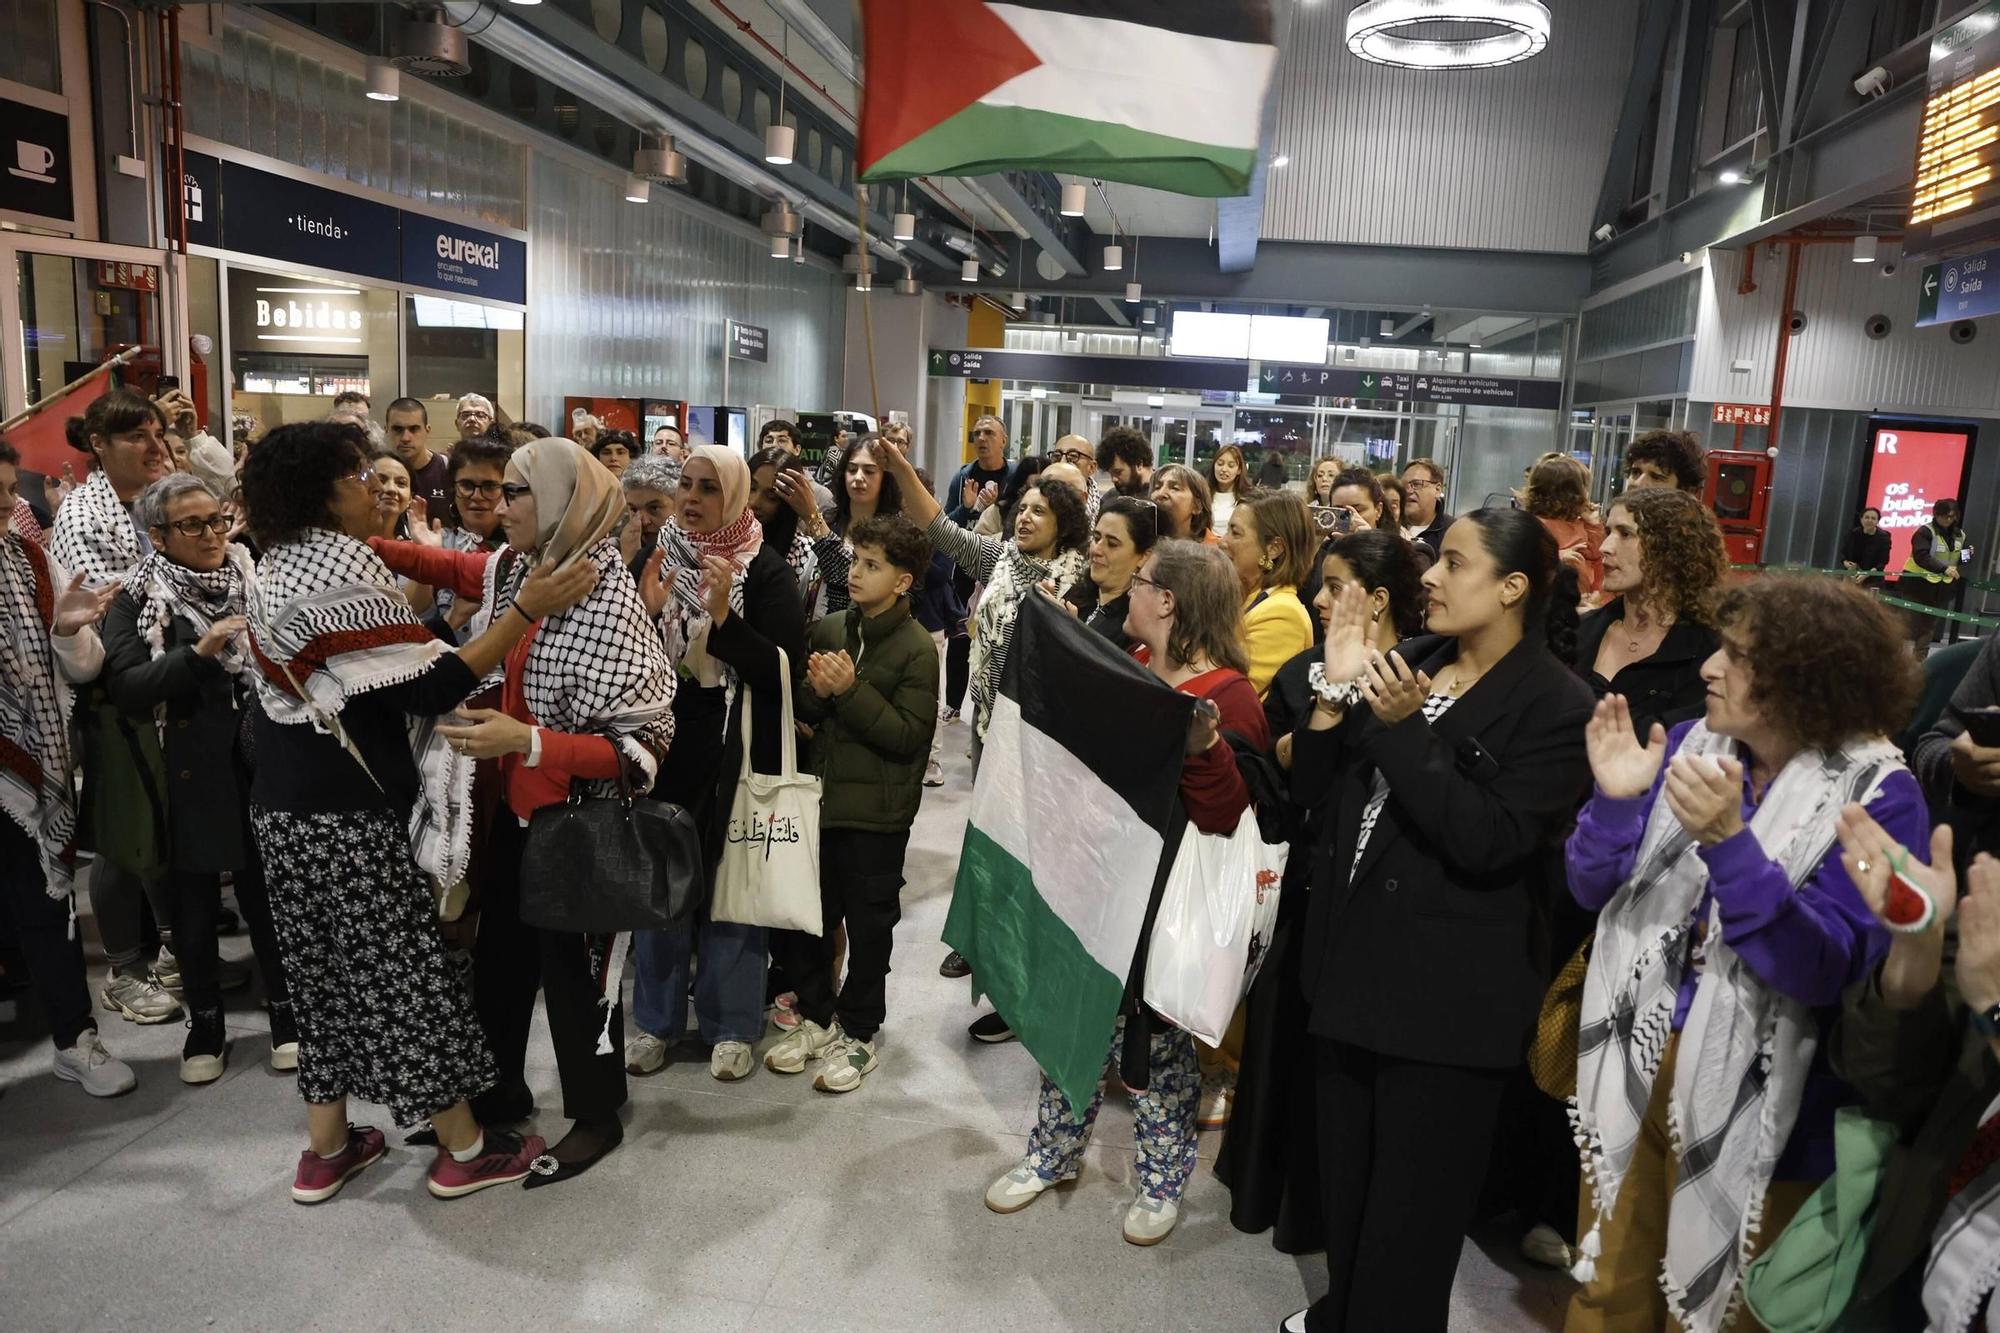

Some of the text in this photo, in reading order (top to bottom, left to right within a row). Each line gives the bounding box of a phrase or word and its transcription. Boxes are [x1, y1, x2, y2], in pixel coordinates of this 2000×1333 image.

[437, 234, 499, 270] eureka!
[1963, 259, 1987, 275] Salida
[443, 273, 454, 282] que
[1960, 278, 1983, 294] Saída
[256, 299, 361, 330] Bebidas
[1320, 372, 1329, 384] P
[1432, 377, 1457, 386] Alquiler
[1468, 379, 1499, 387] vehículos
[1431, 385, 1471, 393] Alugamento
[1483, 387, 1514, 396] vehículos
[1877, 433, 1898, 454] R
[799, 448, 828, 461] ATM
[1885, 483, 1909, 495] os
